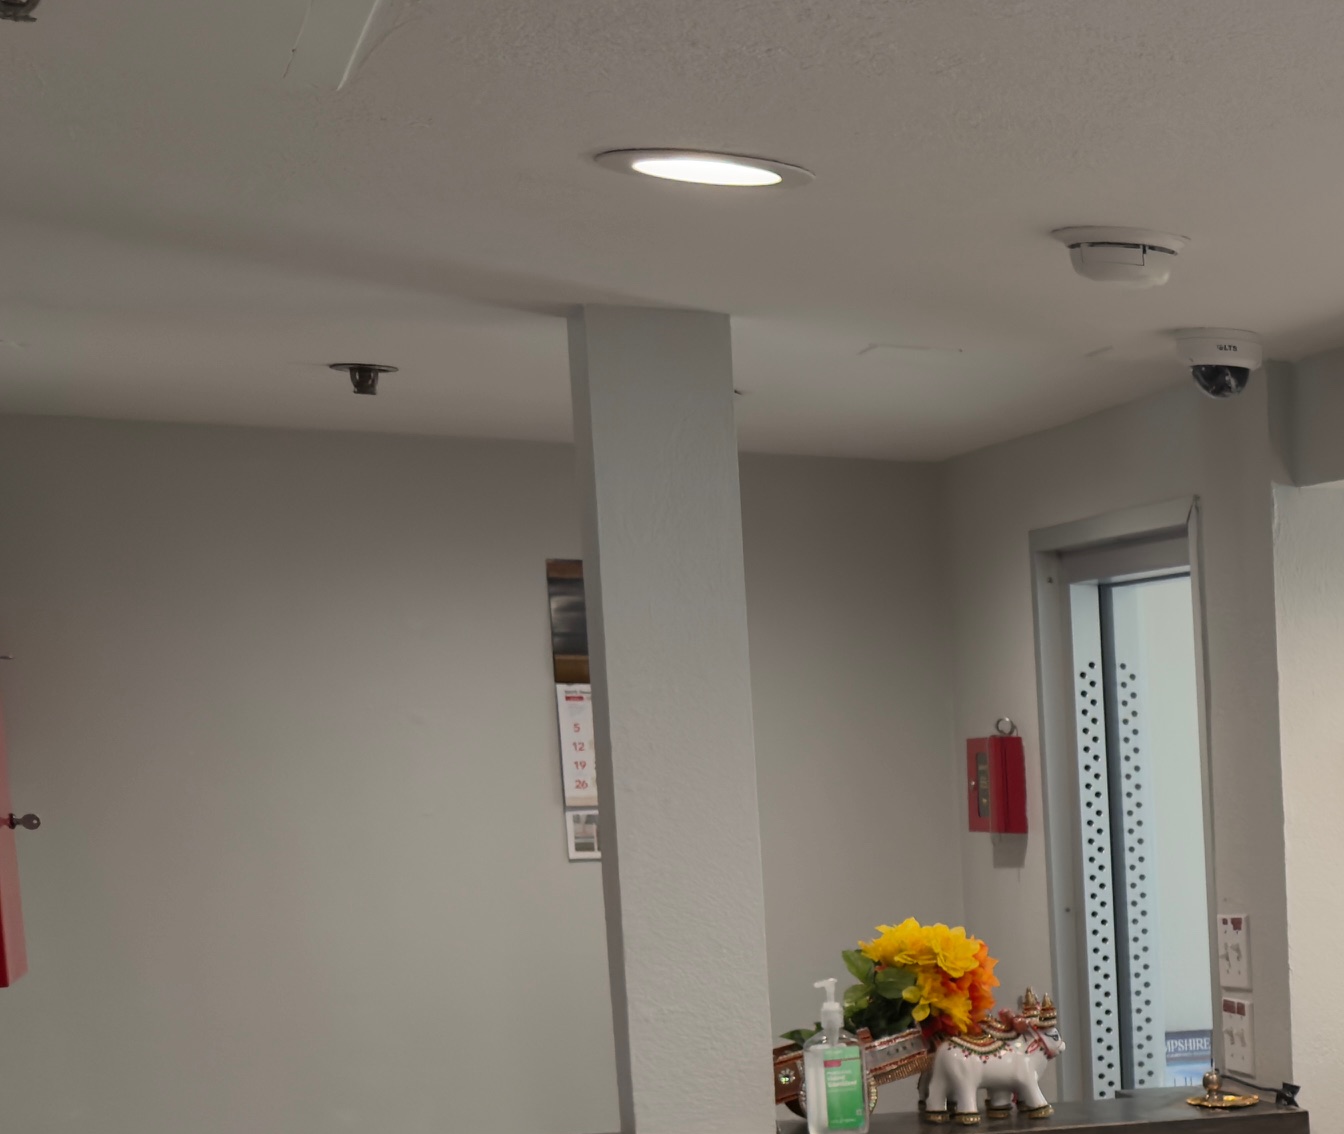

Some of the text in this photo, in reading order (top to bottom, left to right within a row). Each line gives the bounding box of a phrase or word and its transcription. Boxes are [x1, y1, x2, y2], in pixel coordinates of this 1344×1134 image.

[573, 723, 581, 733] 5
[573, 742, 586, 752] 12
[574, 761, 587, 770] 19
[575, 780, 588, 789] 26
